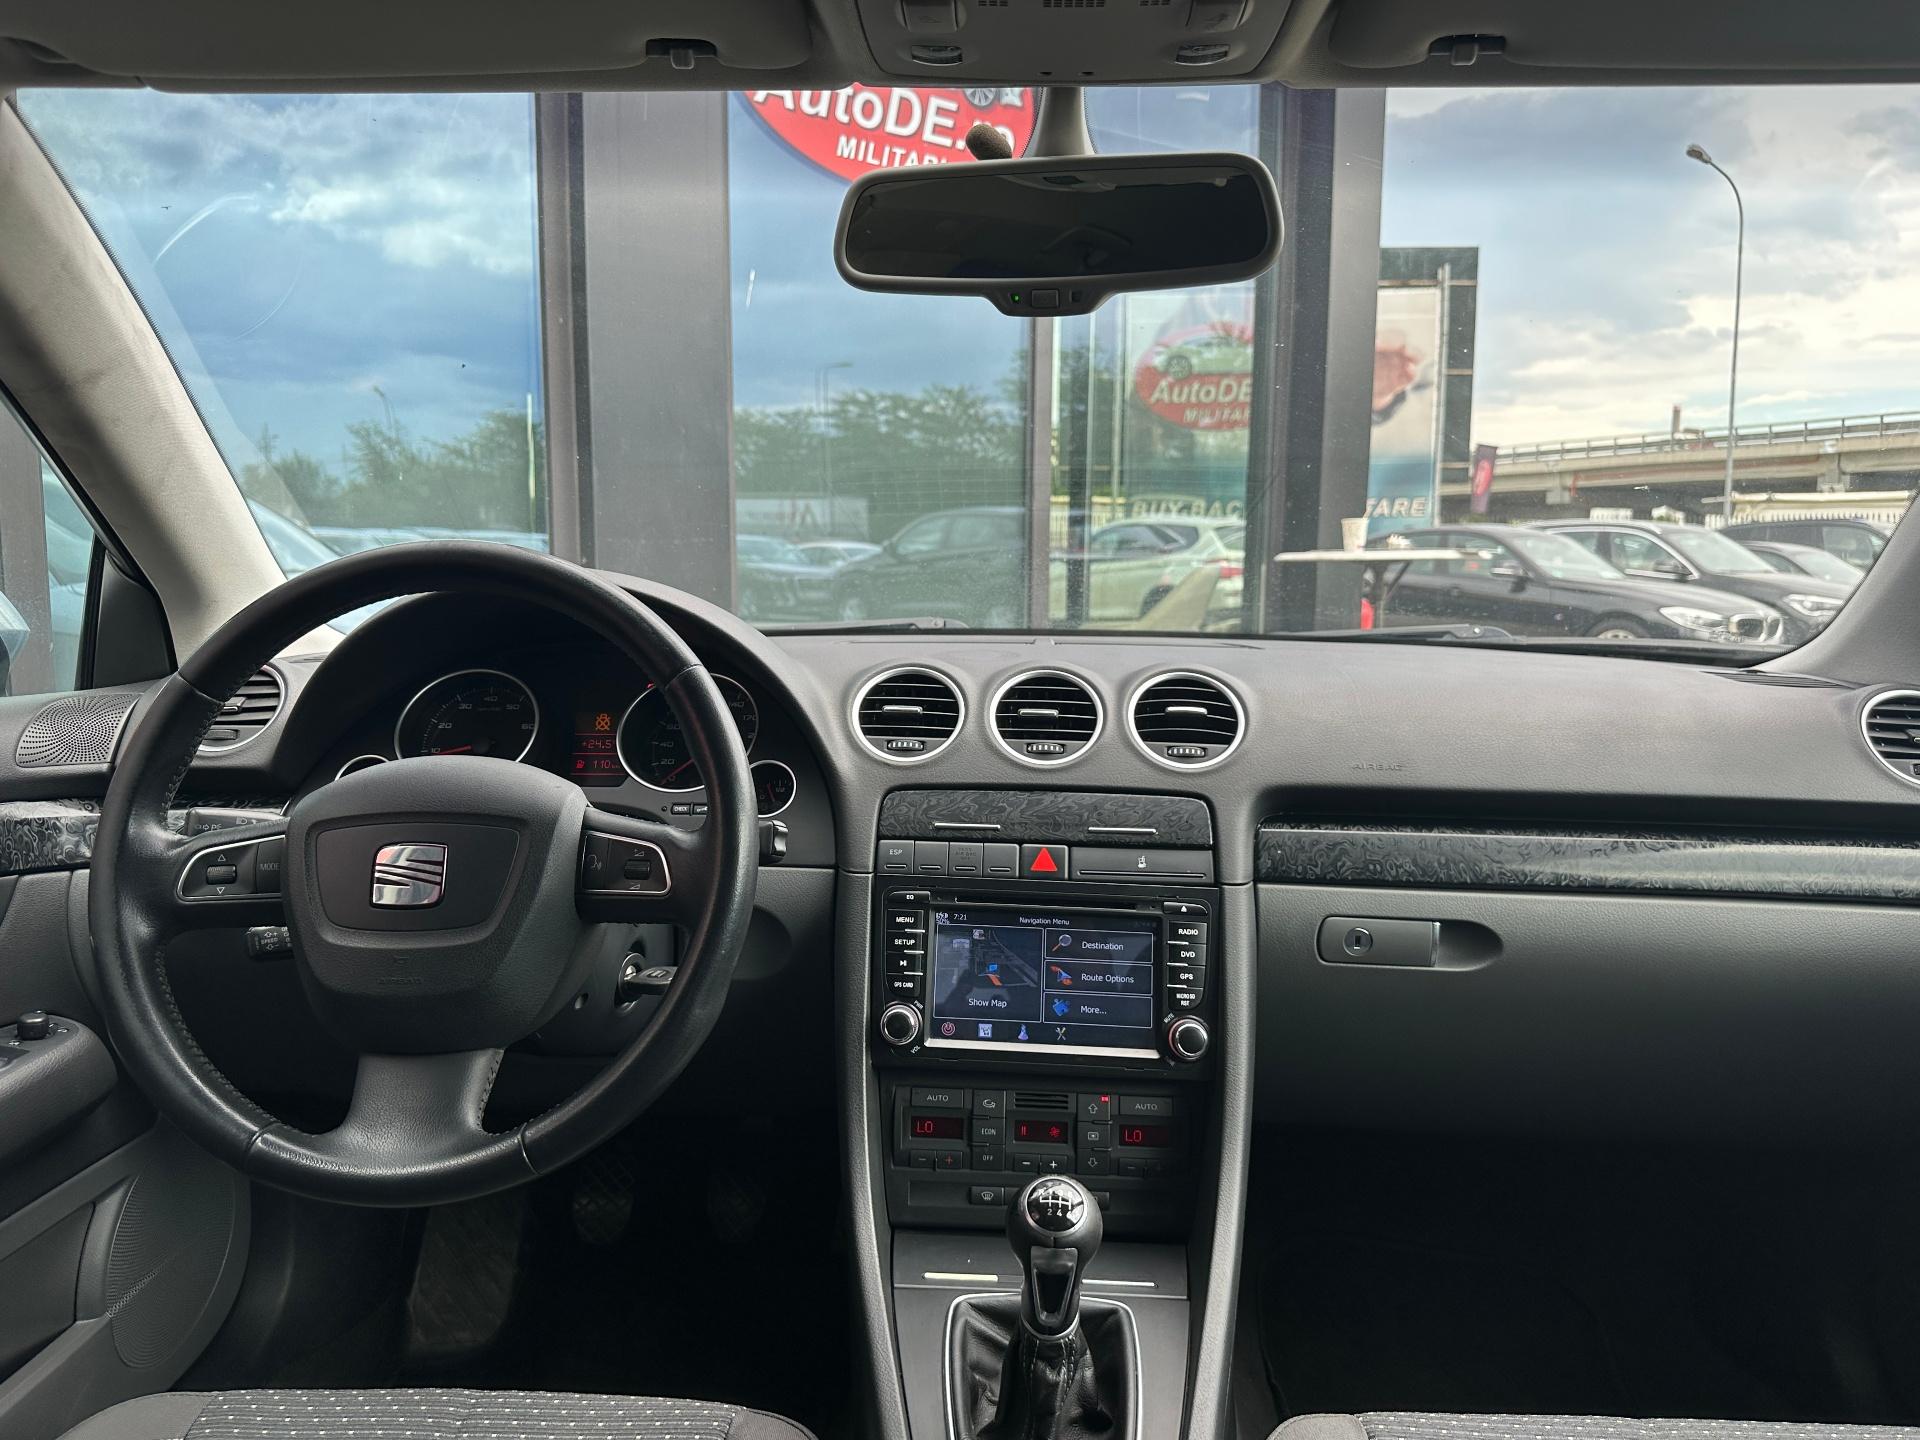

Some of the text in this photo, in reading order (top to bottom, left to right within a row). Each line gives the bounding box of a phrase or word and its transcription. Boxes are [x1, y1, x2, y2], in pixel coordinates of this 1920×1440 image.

[753, 87, 1016, 154] utoDE.
[836, 134, 949, 168] MILITA
[437, 722, 453, 730] 20
[889, 848, 903, 856] ESP
[259, 862, 280, 871] MODE
[895, 915, 915, 924] MENU
[954, 913, 968, 921] 7:21
[1019, 916, 1051, 925] Navigation
[1178, 927, 1199, 937] RADIO
[894, 938, 916, 947] SETUP
[1081, 940, 1124, 951] Destination
[1180, 950, 1196, 959] DVD
[1081, 973, 1135, 985] Route Options
[1179, 972, 1194, 981] GPS
[968, 998, 1008, 1010] Show Map
[1080, 1005, 1107, 1015] More...
[926, 1093, 949, 1103] AUTO
[1134, 1102, 1158, 1111] AUTO
[916, 1120, 934, 1133] LO
[981, 1126, 997, 1137] ECON
[1125, 1129, 1142, 1142] LO
[982, 1153, 994, 1162] OFF
[1047, 1208, 1053, 1216] 2
[1056, 1208, 1063, 1217] 4
